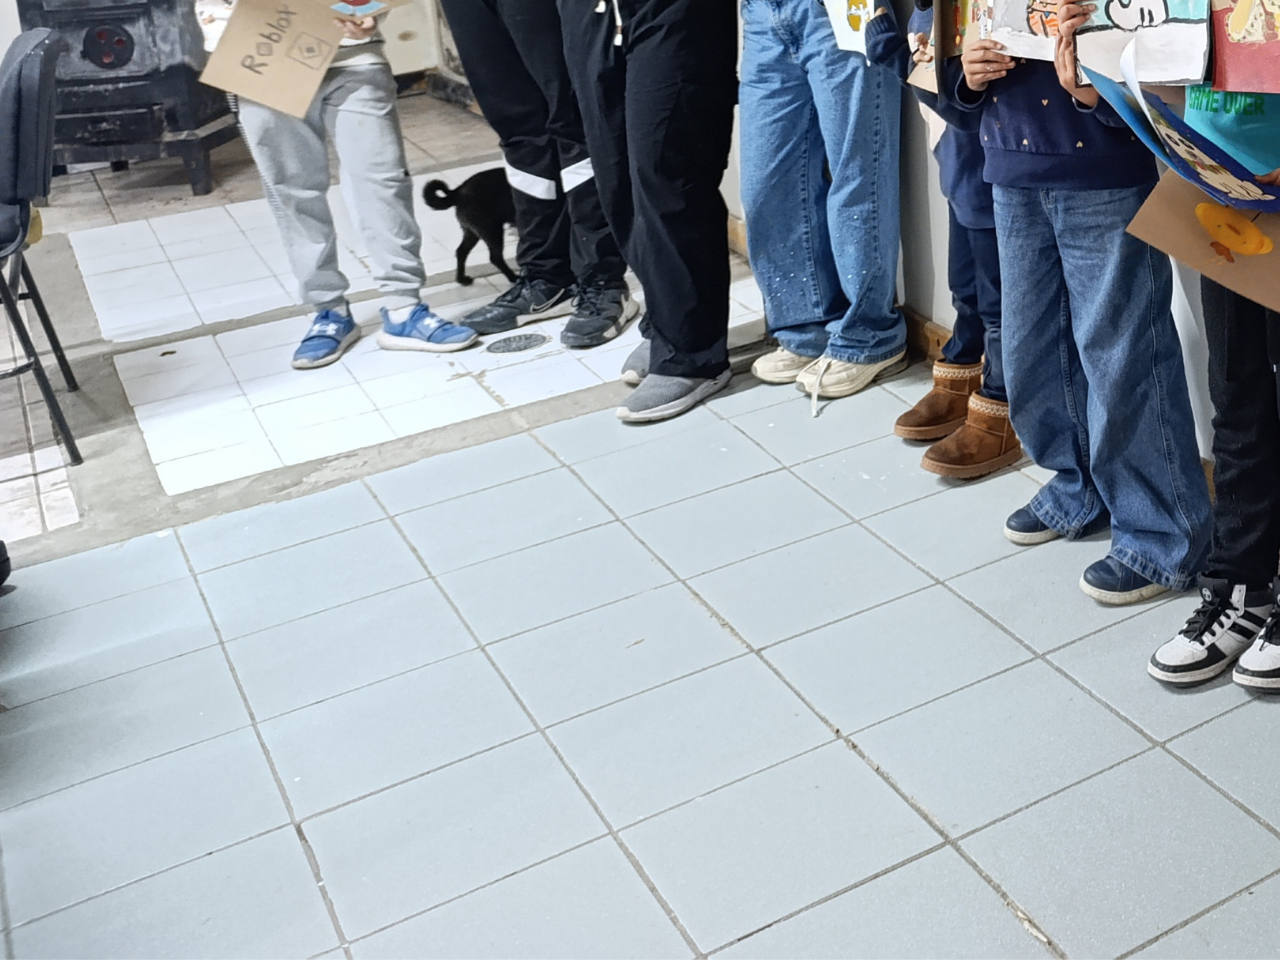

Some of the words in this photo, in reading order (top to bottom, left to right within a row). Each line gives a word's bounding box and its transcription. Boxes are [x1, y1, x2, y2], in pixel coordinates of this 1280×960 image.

[240, 4, 298, 76] Roblox
[1189, 86, 1219, 114] GAME
[1223, 91, 1266, 116] OVER
